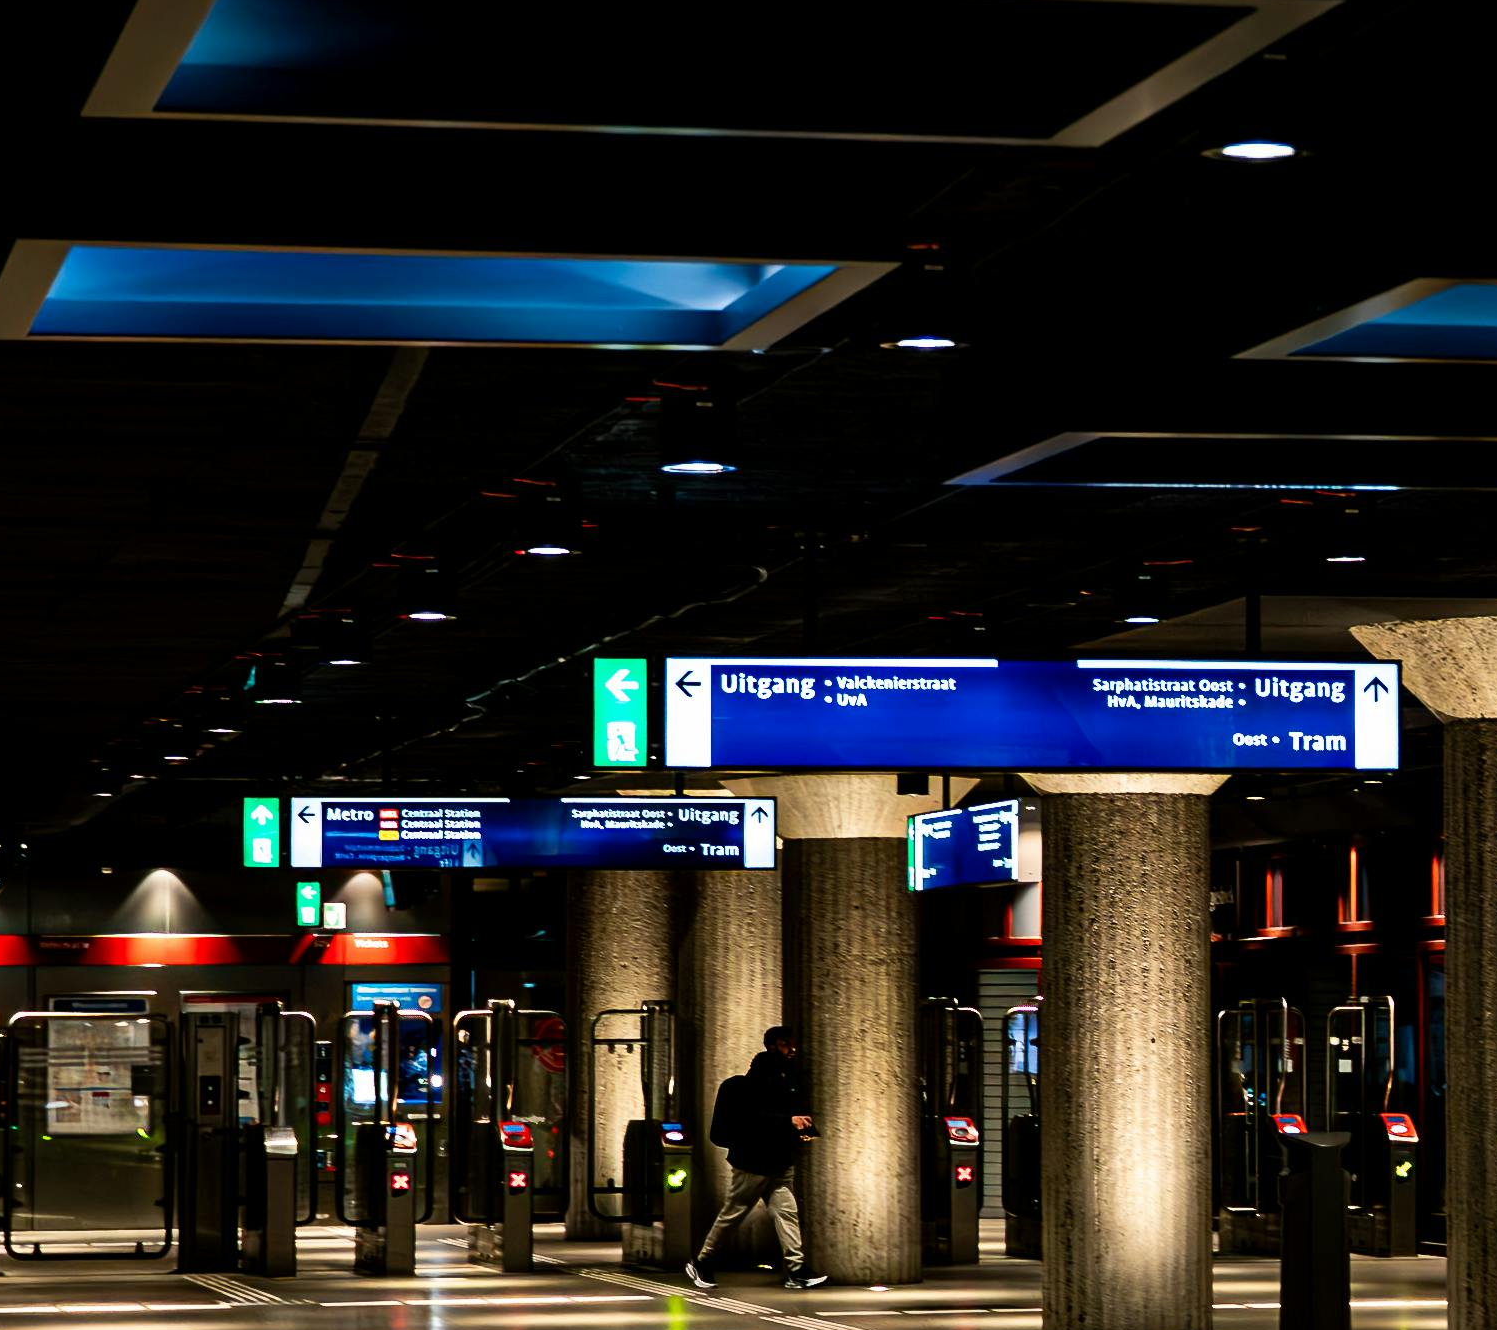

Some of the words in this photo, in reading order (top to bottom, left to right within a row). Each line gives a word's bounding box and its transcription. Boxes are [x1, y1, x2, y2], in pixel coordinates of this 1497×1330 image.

[721, 672, 816, 700] Uitgang
[836, 675, 957, 691] Valckenierstraat
[1092, 677, 1196, 695] Sarphatistraat
[1198, 678, 1234, 693] Oost
[1254, 676, 1346, 704] Uitgang
[836, 692, 868, 707] UvA
[1107, 695, 1142, 710] HvA,
[1143, 694, 1234, 709] Mauritskade
[1232, 732, 1269, 747] Oost
[1288, 731, 1347, 752] Tram
[326, 807, 375, 822] Metro
[401, 808, 444, 818] Centraal
[444, 808, 482, 819] Station
[678, 807, 740, 826] Uitgang
[699, 843, 740, 856] Tram
